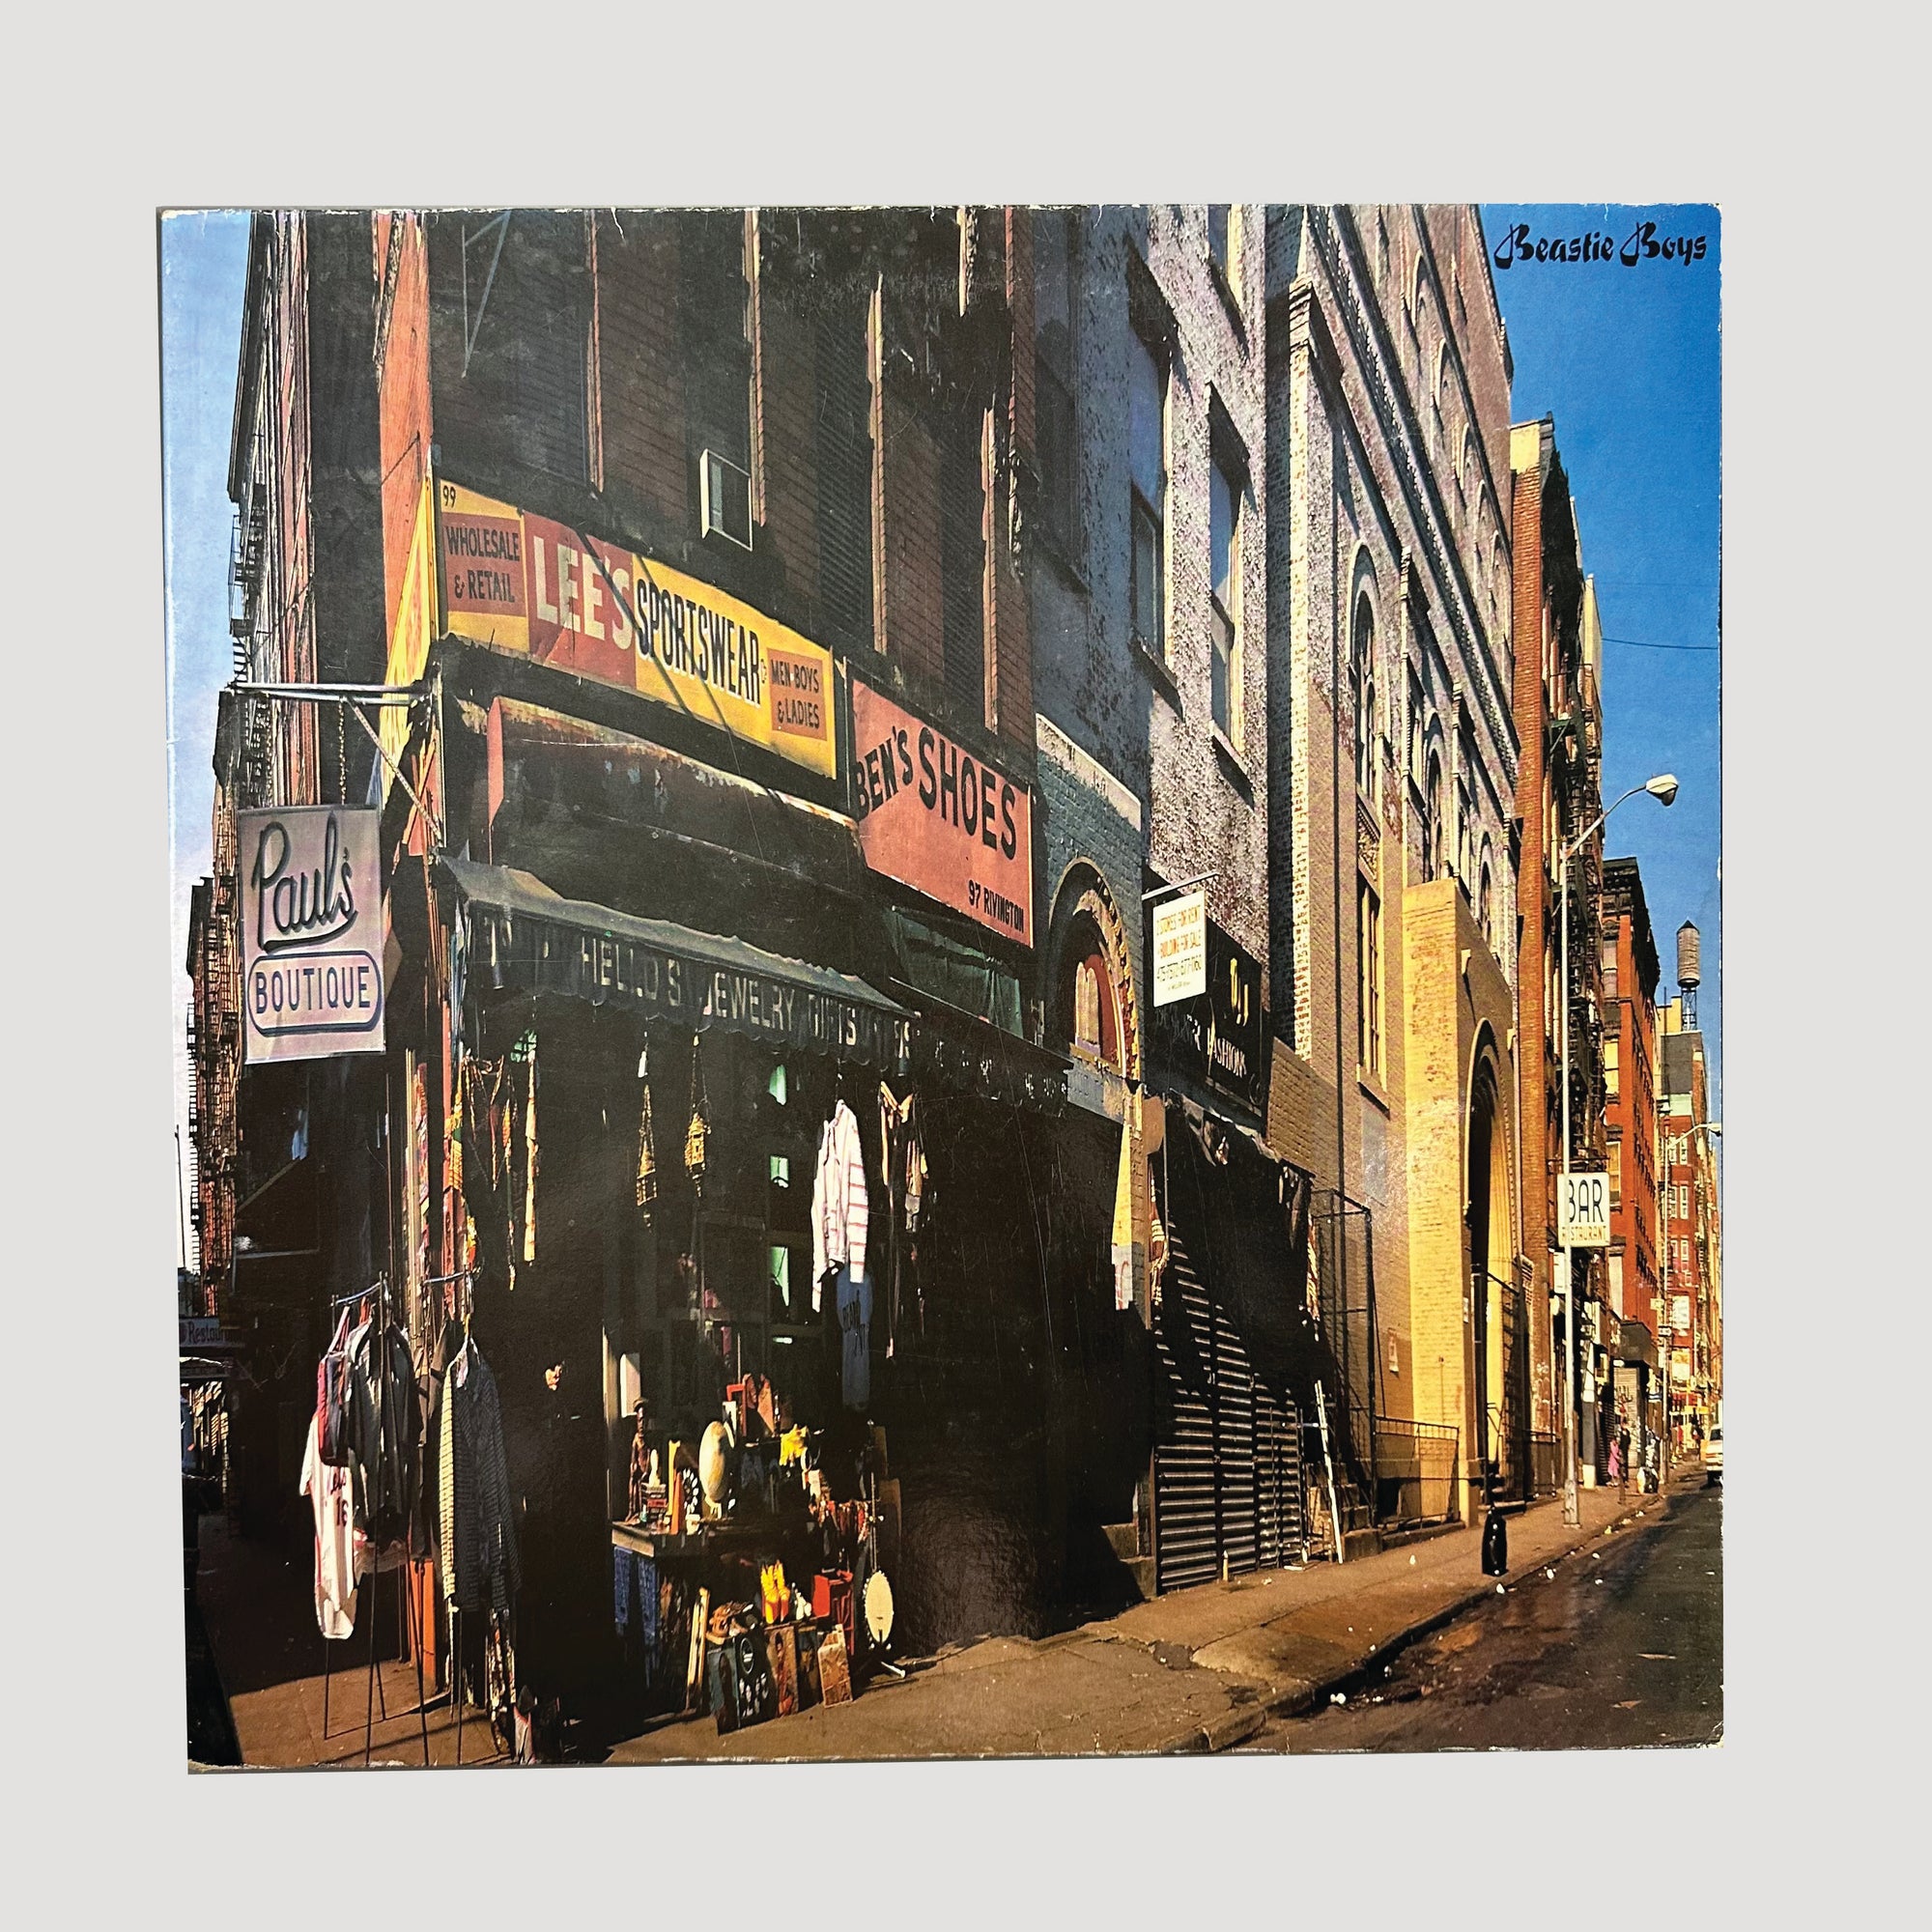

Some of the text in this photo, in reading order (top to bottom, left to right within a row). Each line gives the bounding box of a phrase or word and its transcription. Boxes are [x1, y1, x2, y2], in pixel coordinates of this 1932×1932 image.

[1493, 221, 1707, 270] Beastie Boys
[442, 485, 456, 507] 99
[445, 525, 521, 562] WHOLESALE
[454, 570, 515, 603] & RETAIL
[533, 536, 761, 706] LEE'S SPORTSWEAR
[855, 726, 1015, 861] BEN'S SHOES
[250, 811, 358, 953] Paul's
[968, 879, 1024, 934] 97 RIVINGTON
[255, 966, 371, 1014] BOUTIQUE
[702, 971, 795, 1032] JEWELRY
[1569, 1179, 1604, 1223] BAR
[1562, 1225, 1606, 1241] RSTAURANT
